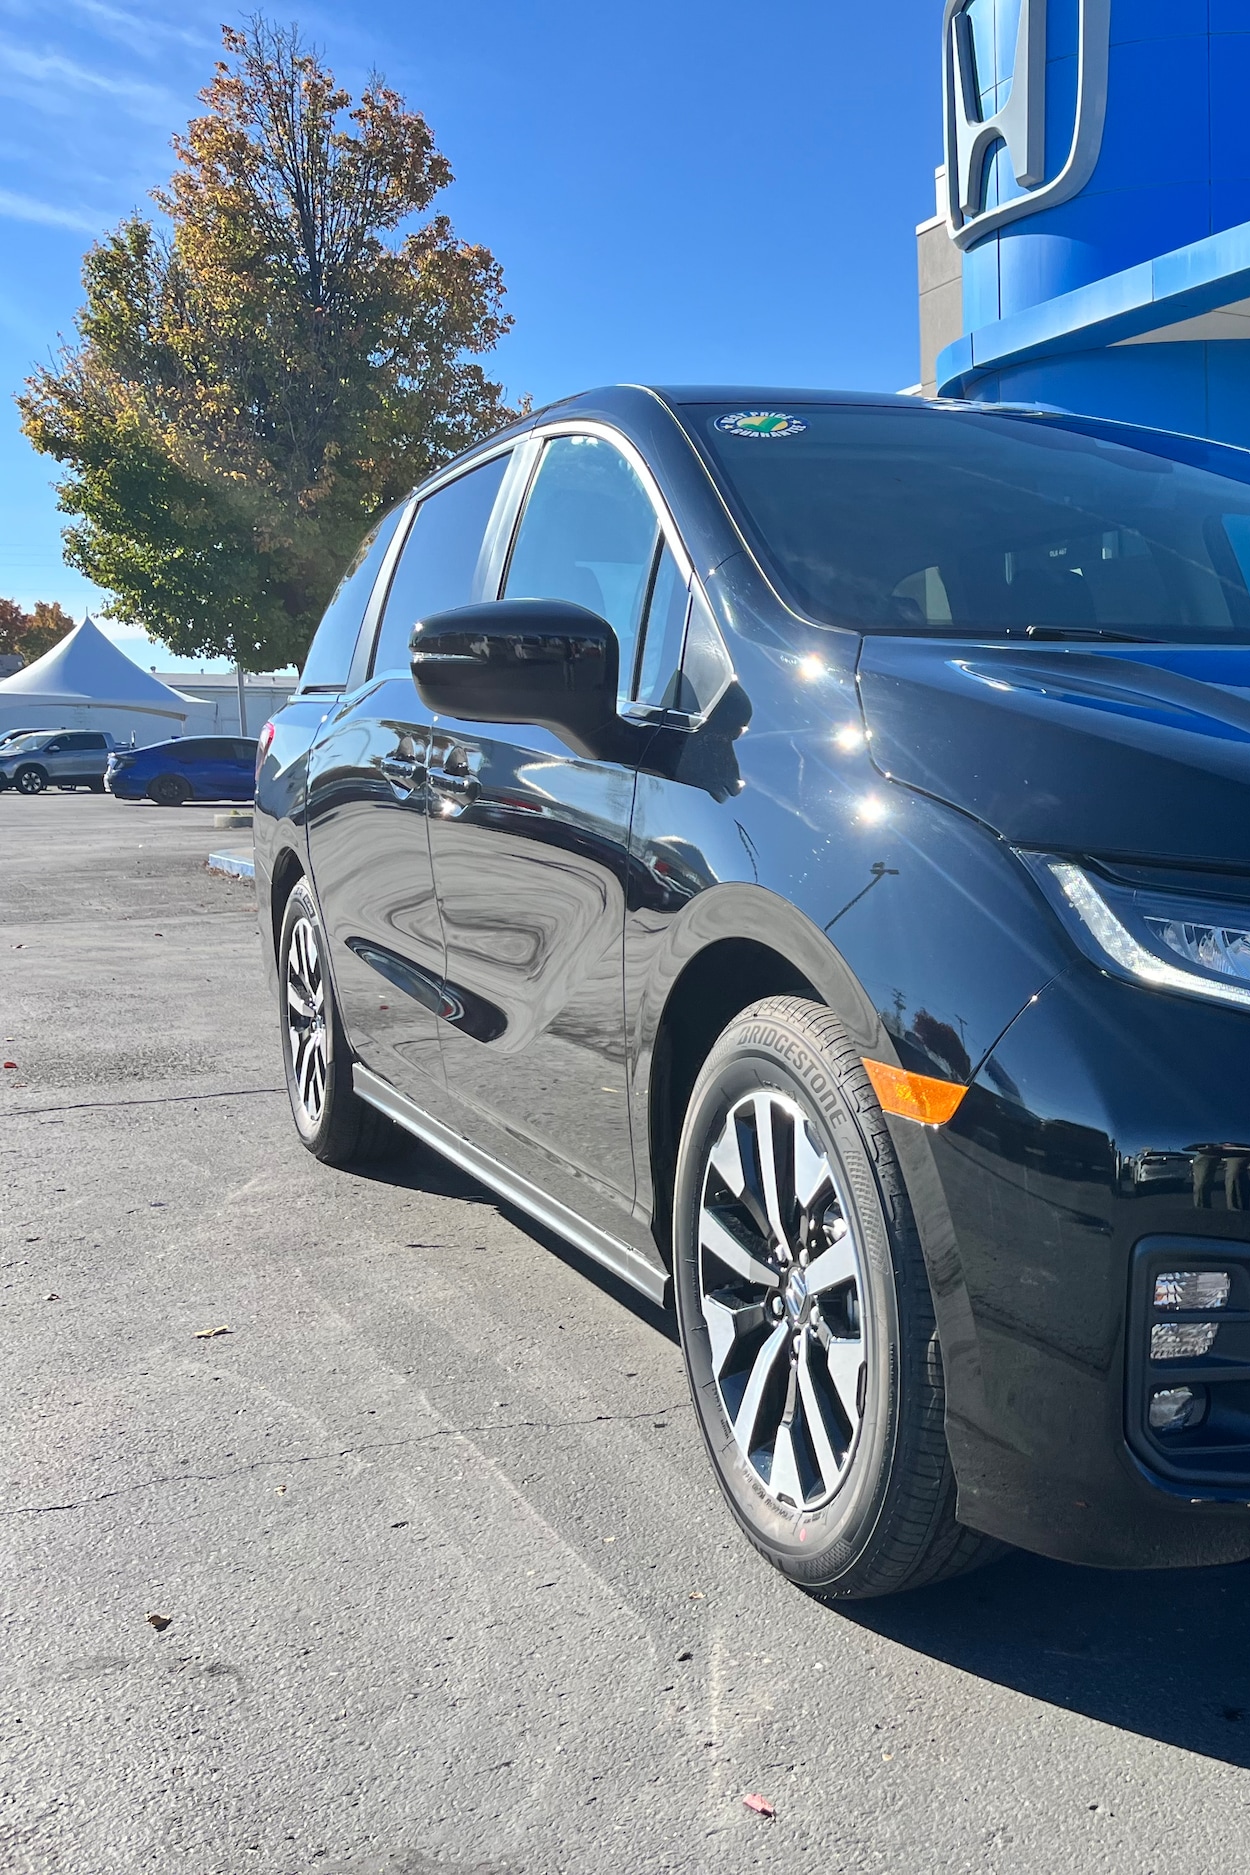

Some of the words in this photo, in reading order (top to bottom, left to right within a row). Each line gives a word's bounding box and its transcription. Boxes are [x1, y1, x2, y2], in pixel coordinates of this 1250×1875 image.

[720, 412, 748, 424] BEST
[749, 411, 795, 420] PRICE
[737, 1024, 848, 1130] BRIDGESTONE
